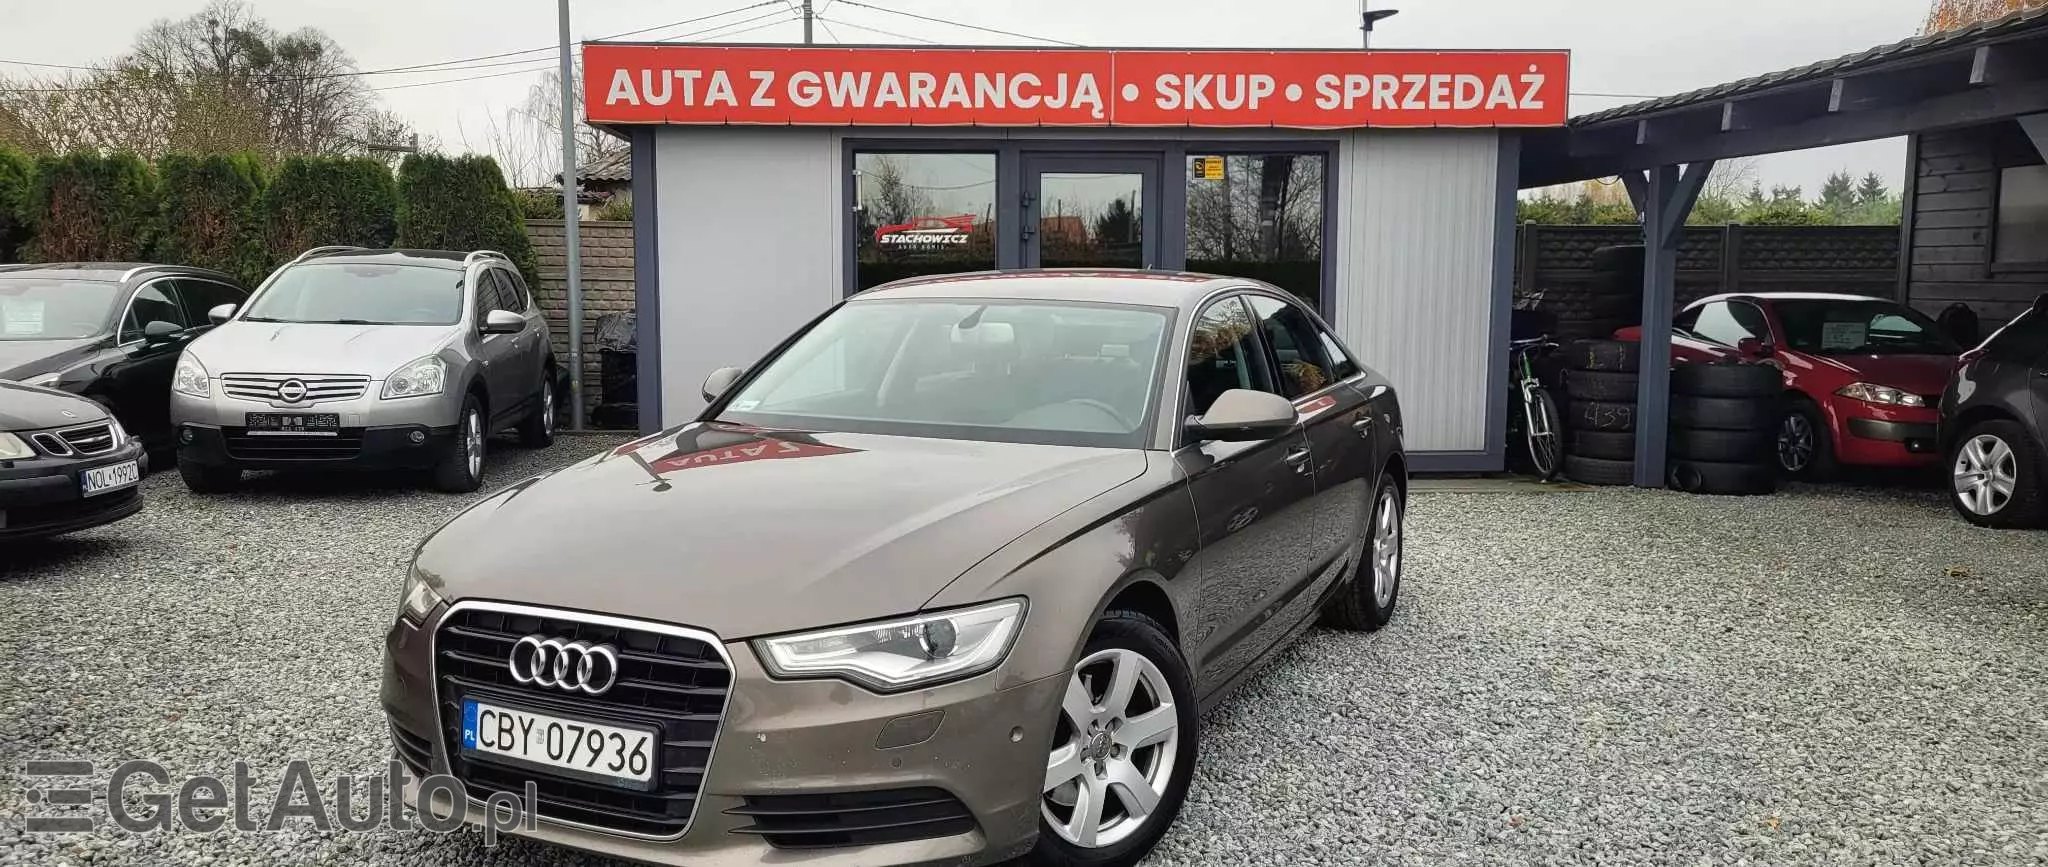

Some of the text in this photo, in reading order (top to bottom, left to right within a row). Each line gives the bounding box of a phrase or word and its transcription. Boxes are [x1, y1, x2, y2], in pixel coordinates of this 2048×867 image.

[605, 64, 1545, 119] AUTA Z GWARANCJĄ SKUP SPRZEDAŻ
[880, 234, 968, 243] STACHOWICZ
[87, 470, 110, 490] NOL
[464, 729, 475, 741] PL
[479, 709, 648, 775] CBY 07936
